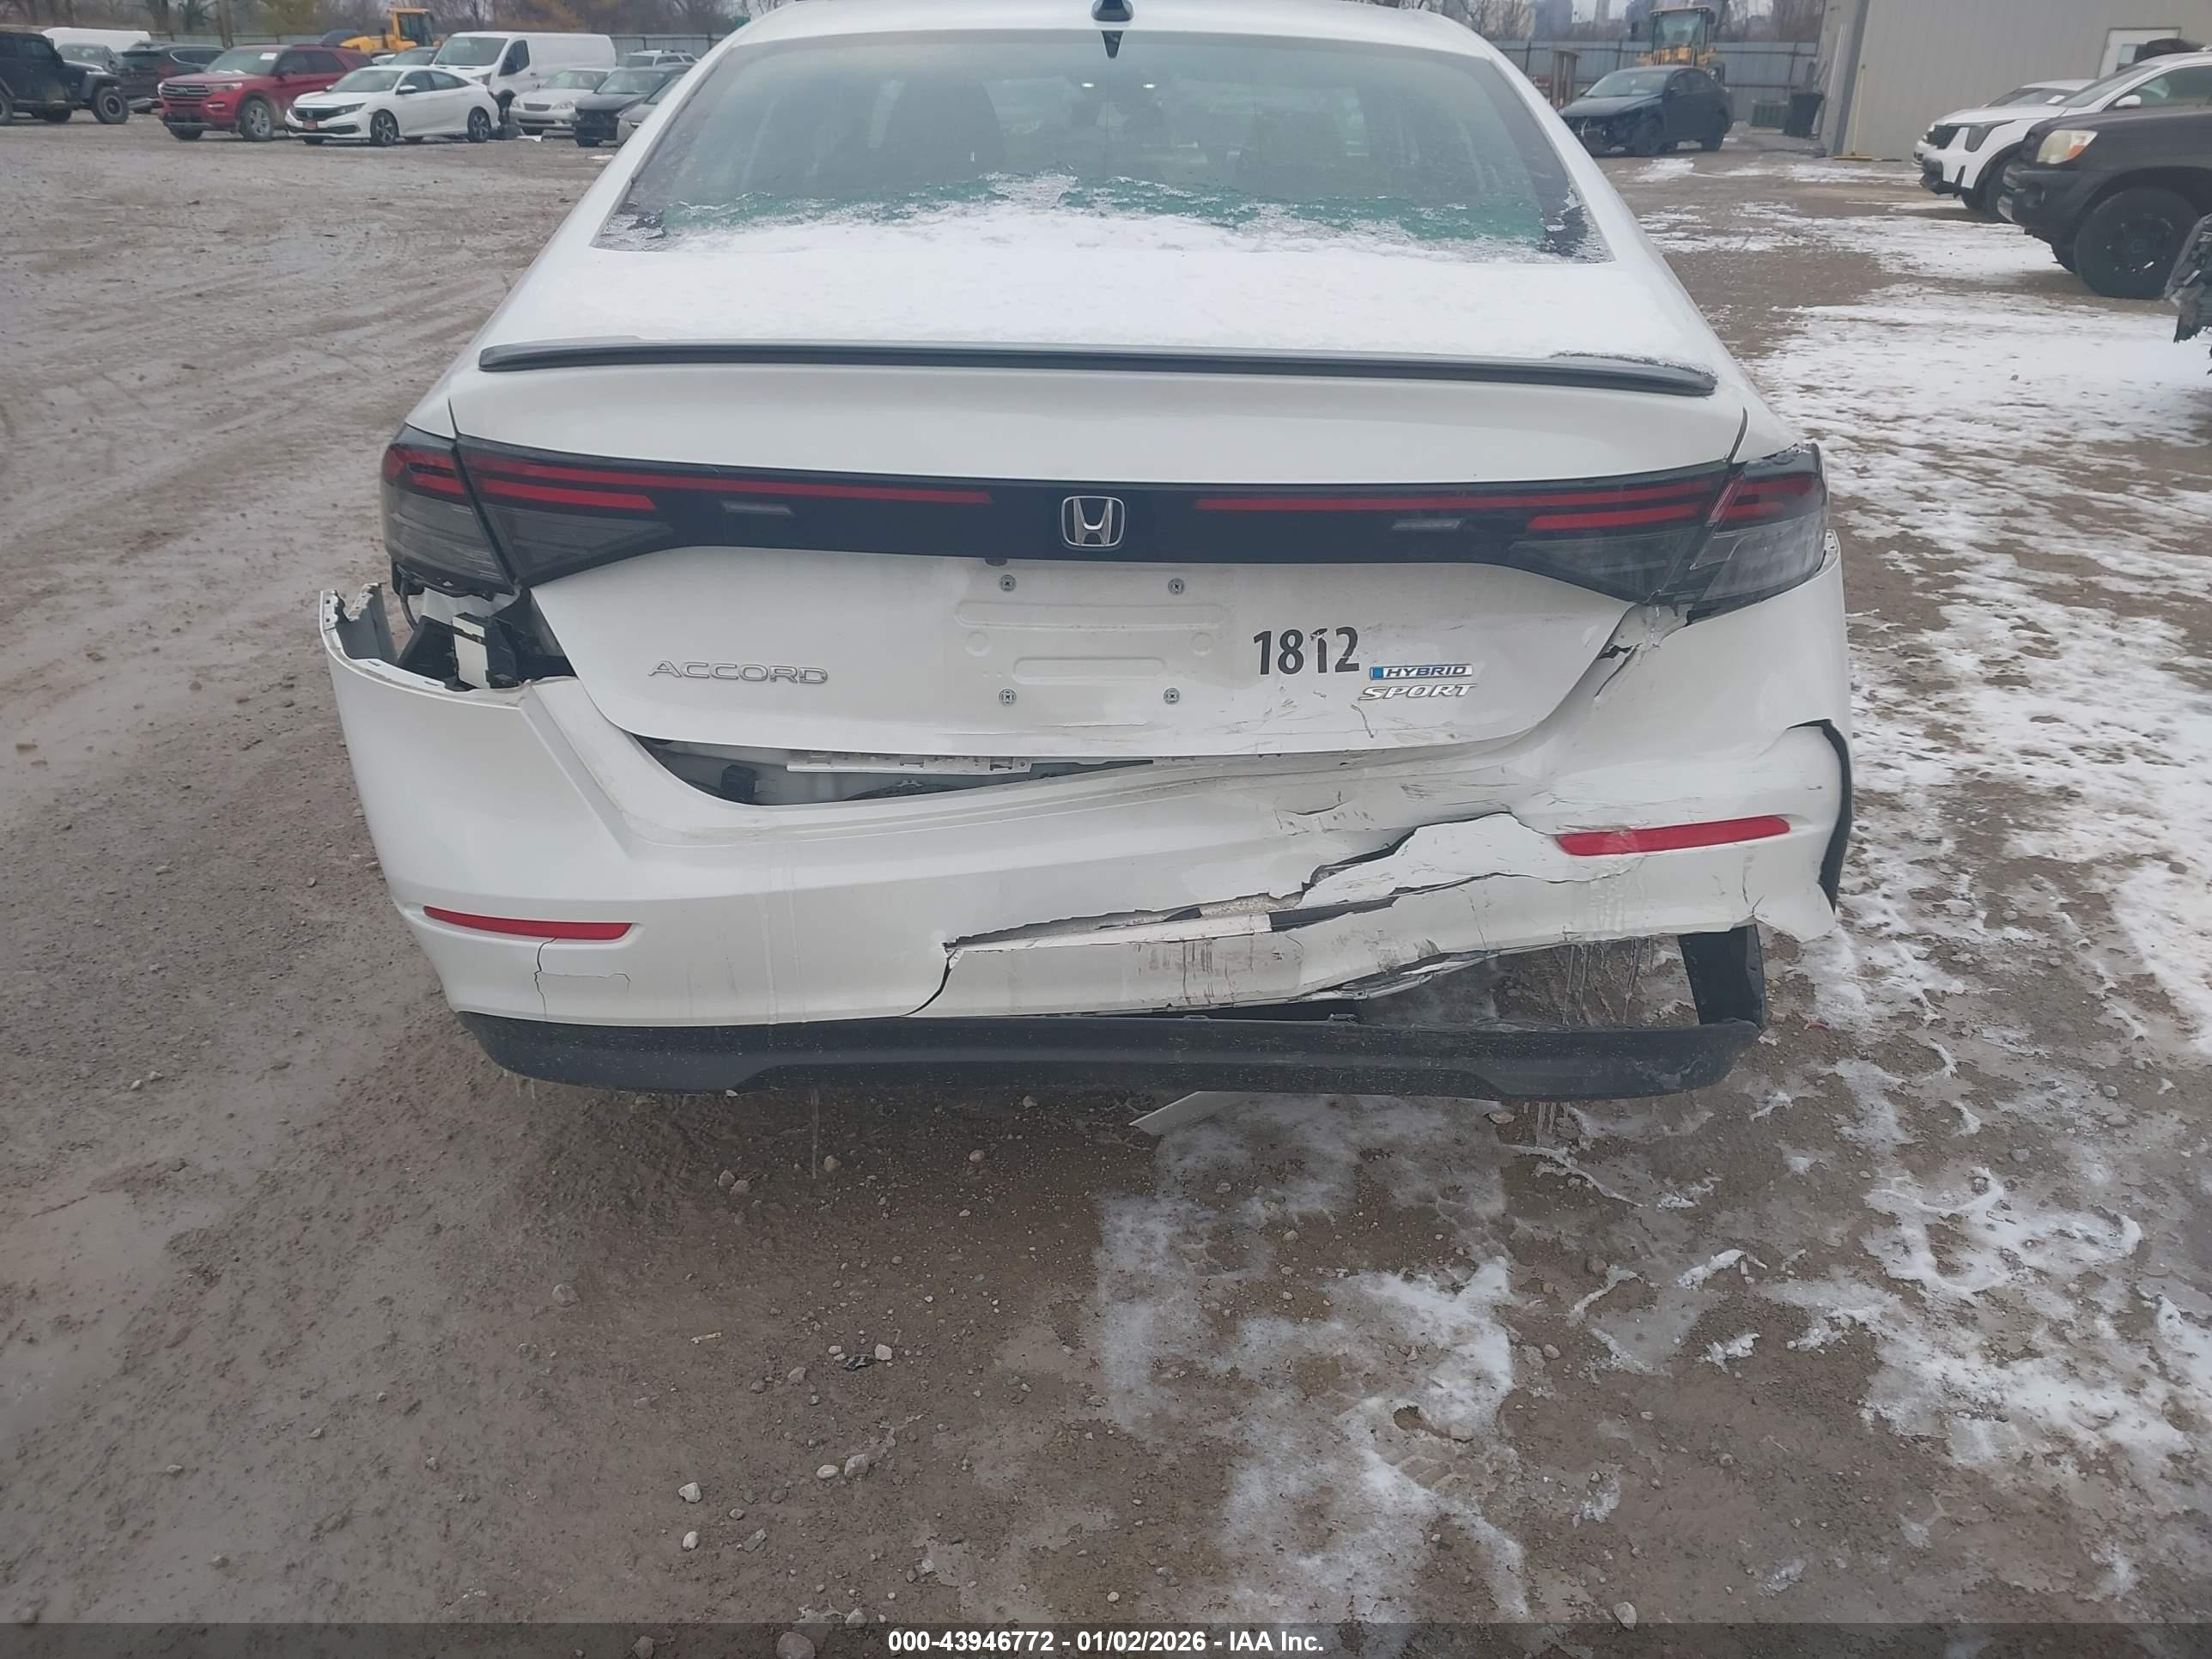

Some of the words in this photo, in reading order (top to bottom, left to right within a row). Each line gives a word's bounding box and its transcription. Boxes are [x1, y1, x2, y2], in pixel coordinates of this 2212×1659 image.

[1253, 626, 1359, 675] 1812
[648, 660, 829, 684] ACCORD
[1385, 665, 1469, 678] HYBRID
[1358, 683, 1477, 701] SPORT
